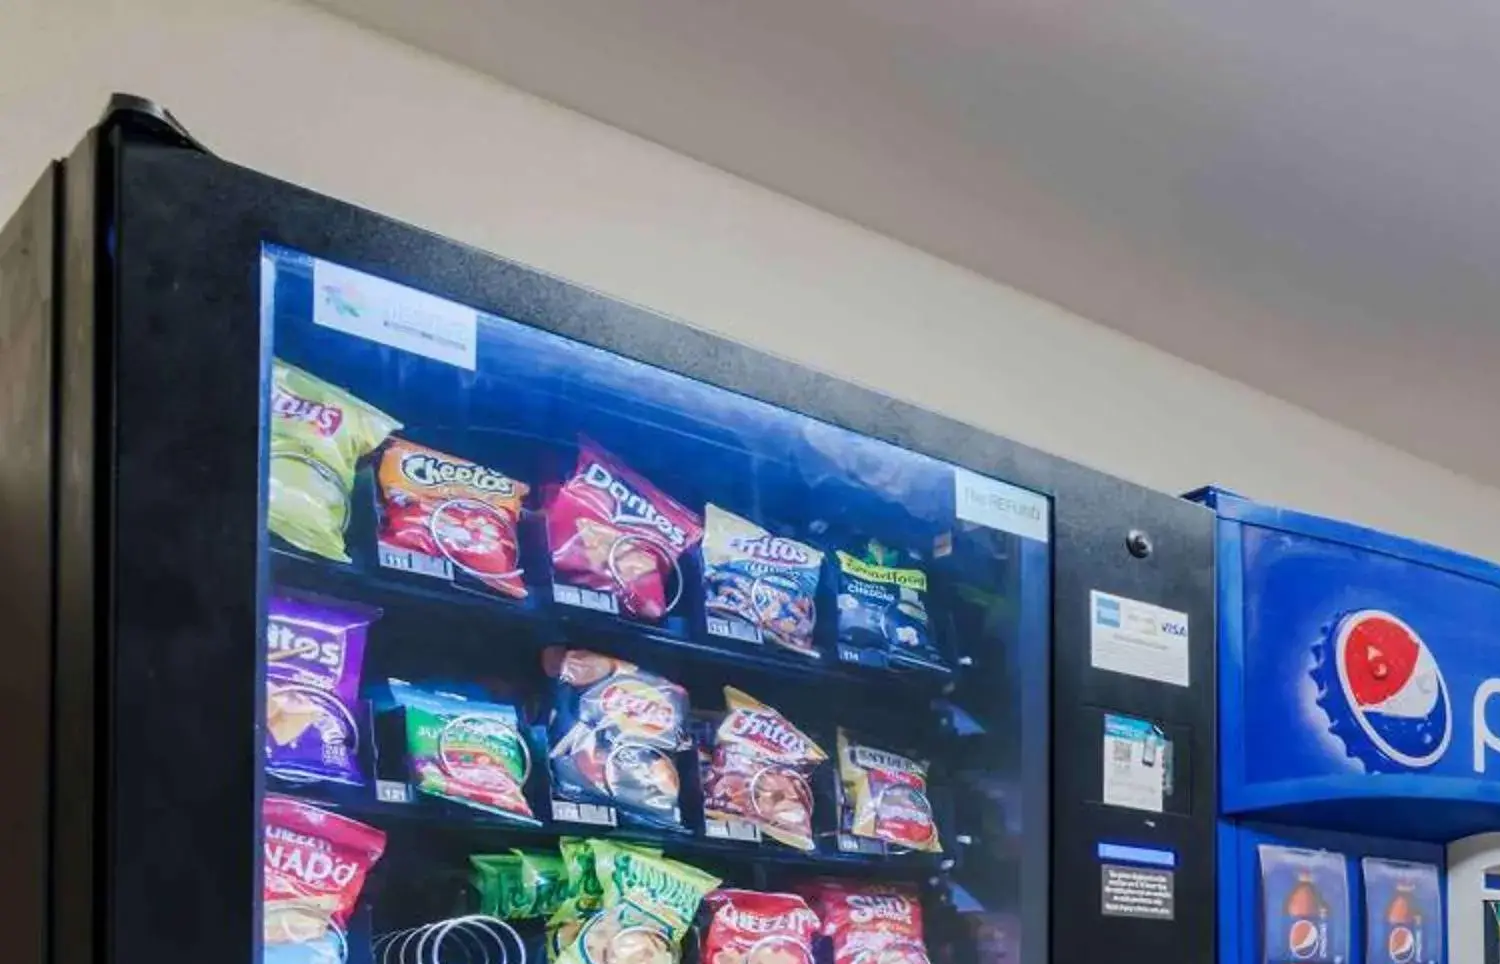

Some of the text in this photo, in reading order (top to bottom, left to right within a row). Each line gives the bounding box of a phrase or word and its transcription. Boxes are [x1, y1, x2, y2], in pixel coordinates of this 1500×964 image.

[401, 452, 516, 497] Cheetos
[584, 463, 689, 547] Doritos
[725, 534, 812, 566] Fritos
[267, 624, 341, 666] itos
[1161, 620, 1188, 639] VISA
[264, 842, 359, 887] NAP'd
